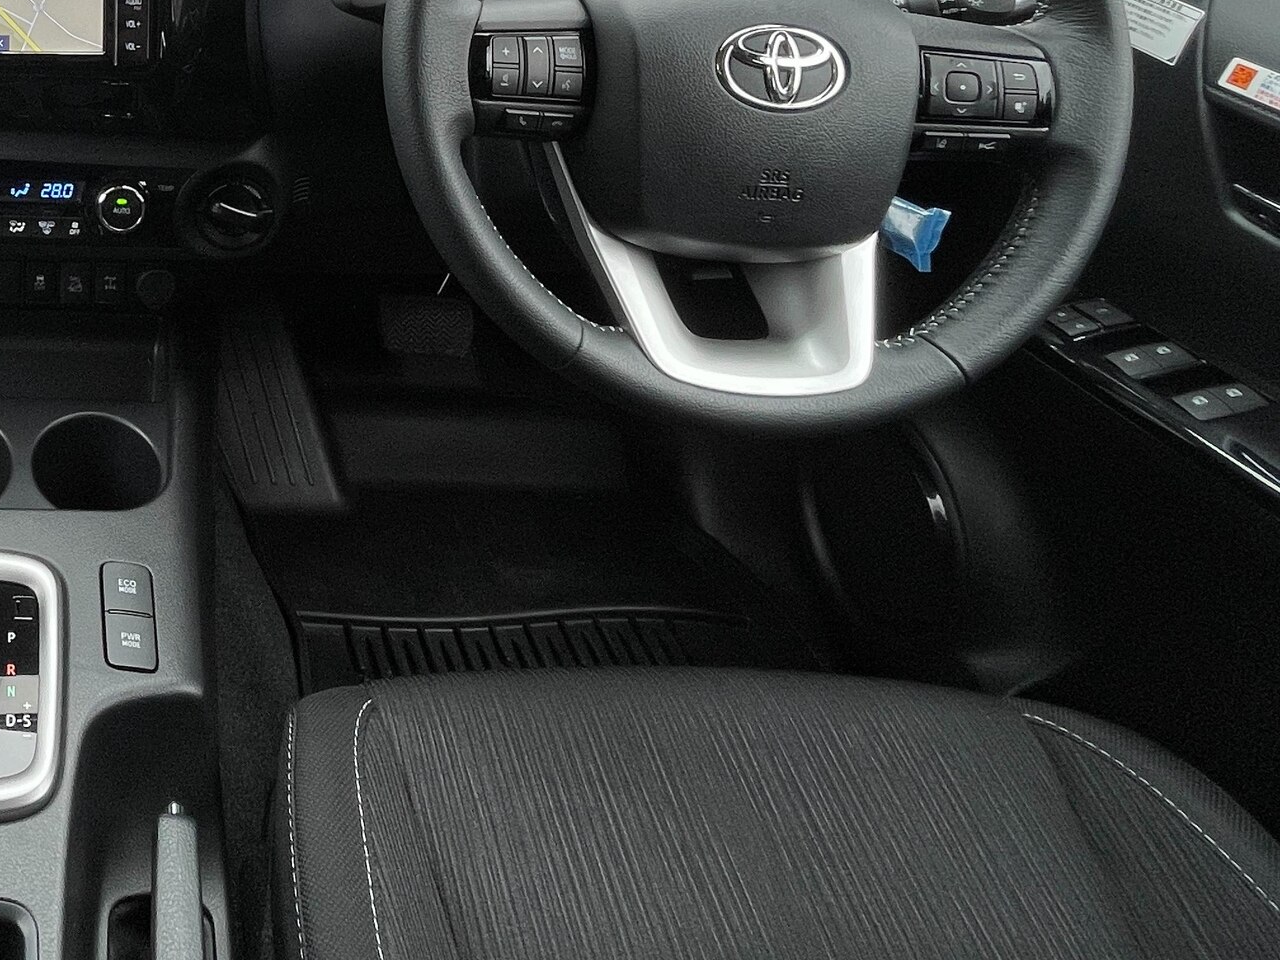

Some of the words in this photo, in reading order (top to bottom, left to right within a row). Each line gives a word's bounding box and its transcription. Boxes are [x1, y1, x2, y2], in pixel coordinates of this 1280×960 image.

[40, 182, 75, 198] 28.0
[737, 187, 804, 202] AIRBAG
[112, 206, 131, 215] AUTO
[118, 578, 137, 588] ECO
[118, 586, 137, 595] MODE
[7, 631, 16, 643] P
[120, 631, 141, 642] PWR
[121, 640, 141, 649] MODE
[6, 663, 16, 676] R
[7, 685, 16, 697] N
